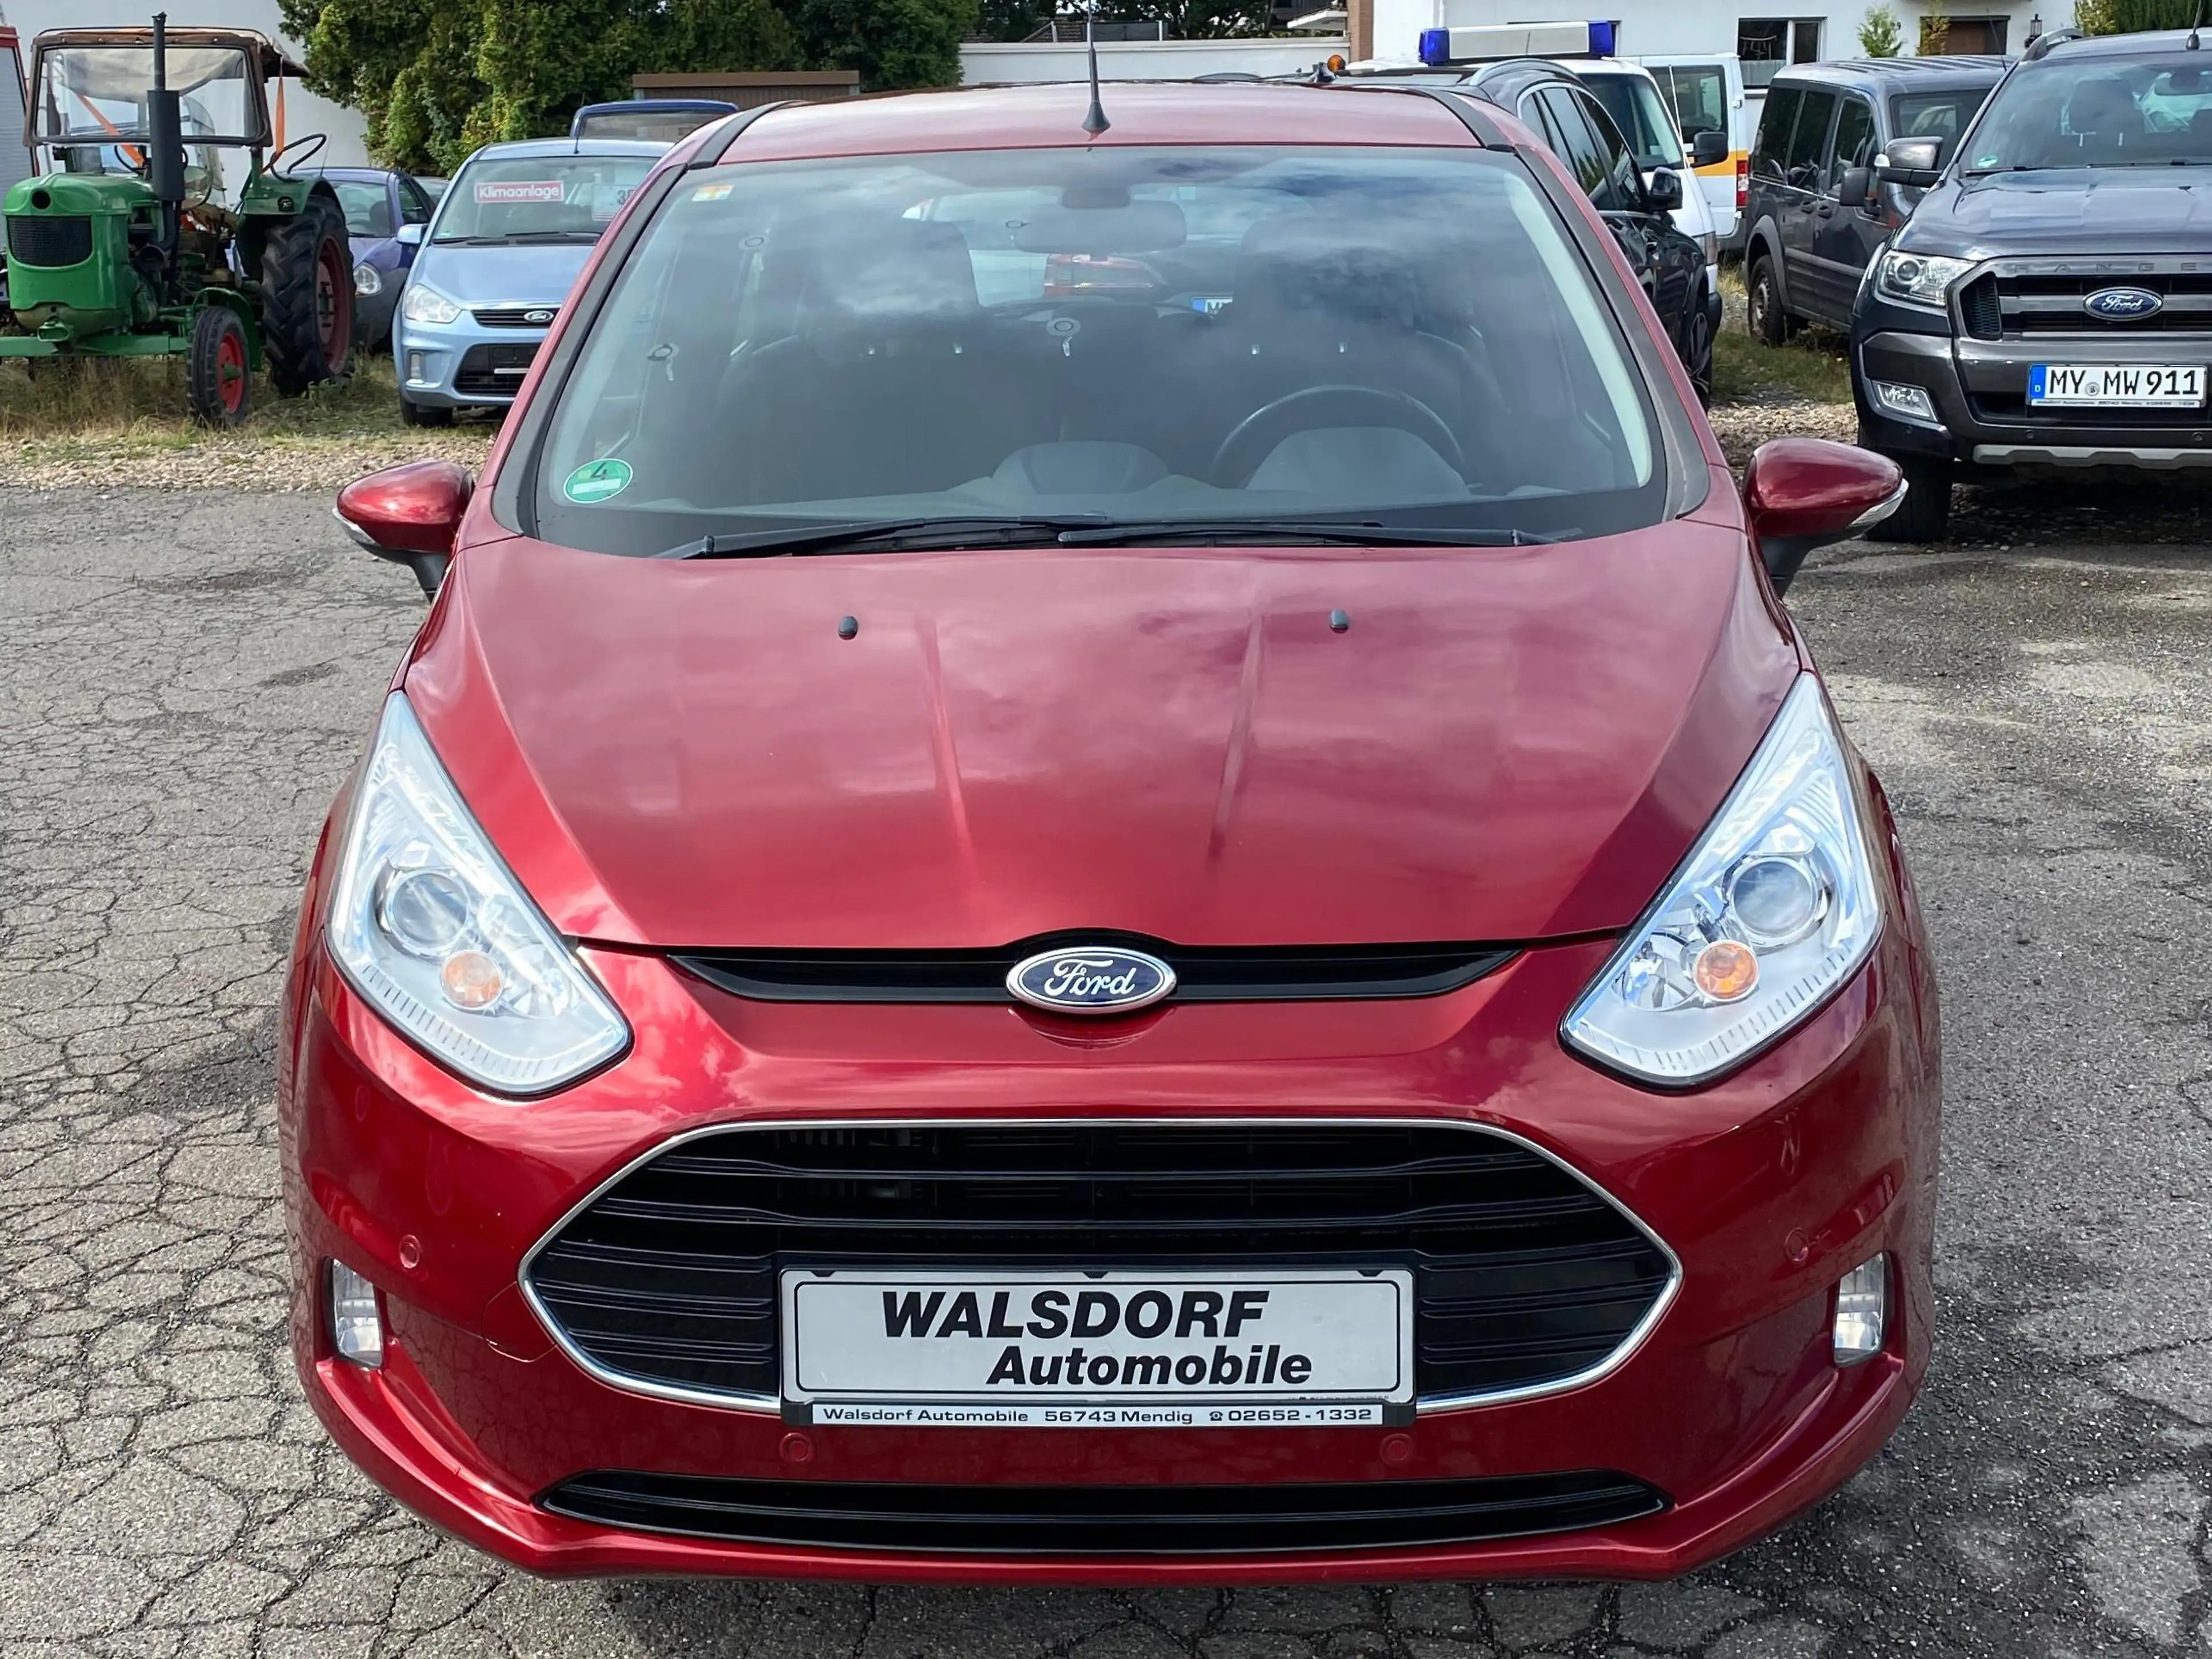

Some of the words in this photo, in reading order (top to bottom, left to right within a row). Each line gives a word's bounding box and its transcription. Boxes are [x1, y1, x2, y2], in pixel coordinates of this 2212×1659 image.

[479, 185, 559, 199] Klimaanlage
[2102, 294, 2144, 310] Ford
[2050, 370, 2086, 394] MY
[2104, 370, 2140, 395] MW
[2146, 370, 2199, 395] 911
[590, 461, 607, 480] 4
[1044, 959, 1136, 997] Ford
[882, 1290, 1271, 1339] WALSDORF
[985, 1344, 1313, 1385] Automobile
[823, 1408, 913, 1421] Walsdorf
[917, 1410, 1029, 1422] Automobile
[1045, 1411, 1117, 1422] 56743
[1121, 1410, 1193, 1425] Mendig
